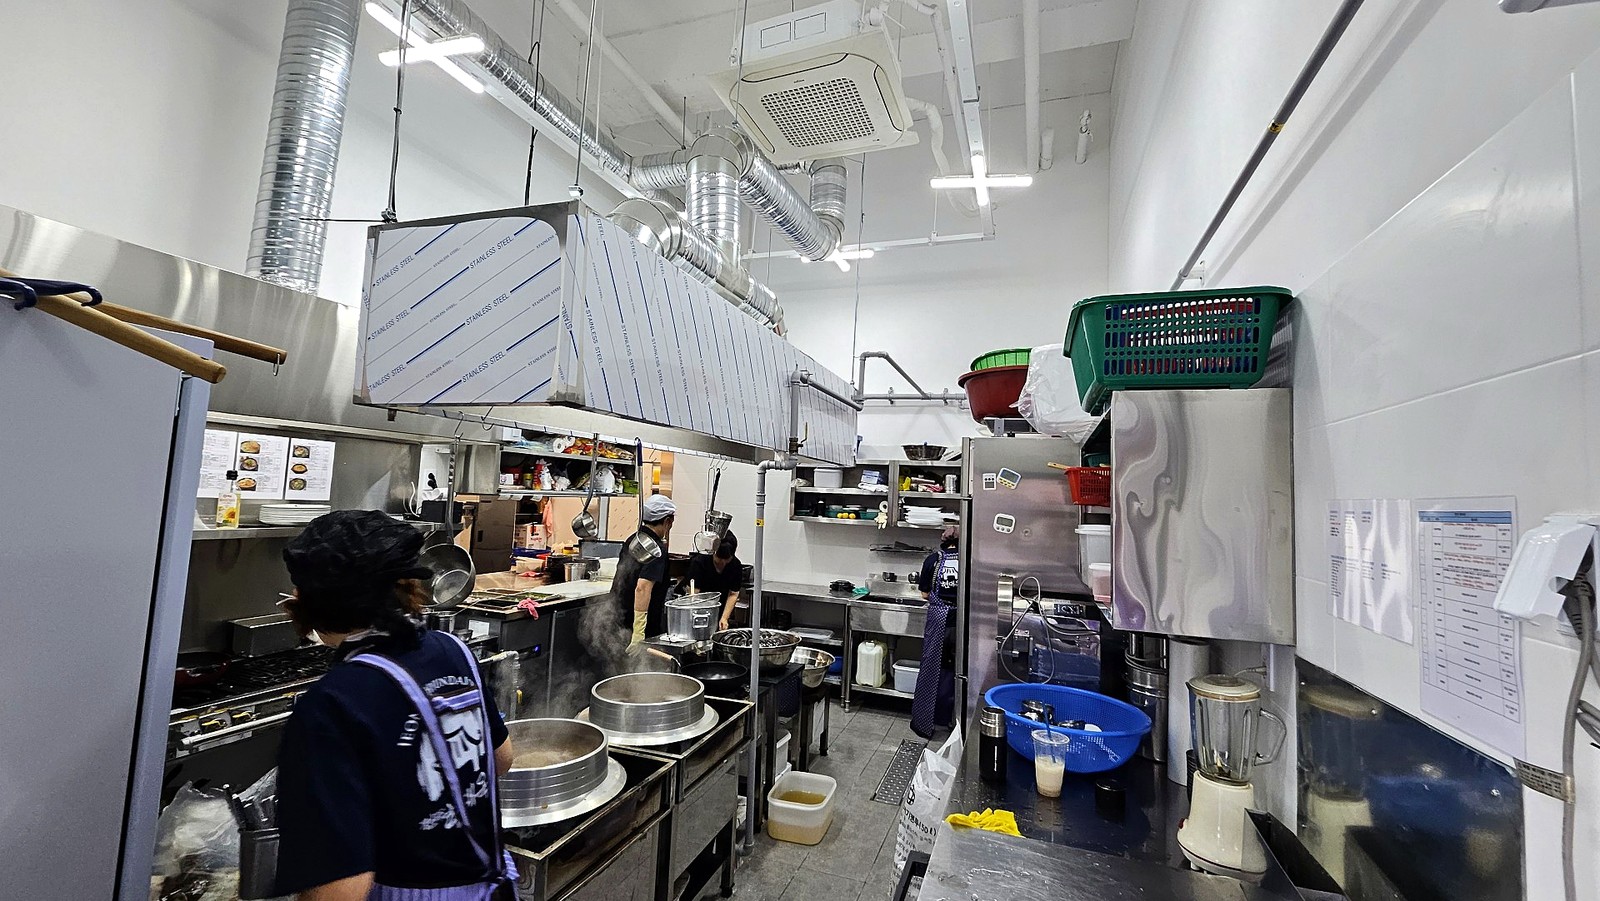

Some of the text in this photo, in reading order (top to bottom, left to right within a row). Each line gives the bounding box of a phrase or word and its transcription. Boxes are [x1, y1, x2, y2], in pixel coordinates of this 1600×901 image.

[470, 236, 512, 269] STAINLESS STEEL
[376, 255, 413, 287] STAINLESS STEEL
[371, 309, 409, 340] STAINLESS STEEL
[466, 293, 509, 326] STAINLESS STEEL
[585, 309, 599, 344] STAINLESS
[594, 346, 604, 364] STEEL
[621, 324, 633, 356] STAINLESS
[391, 364, 406, 377] STEEL
[462, 351, 505, 383] STAINLESS STEEL
